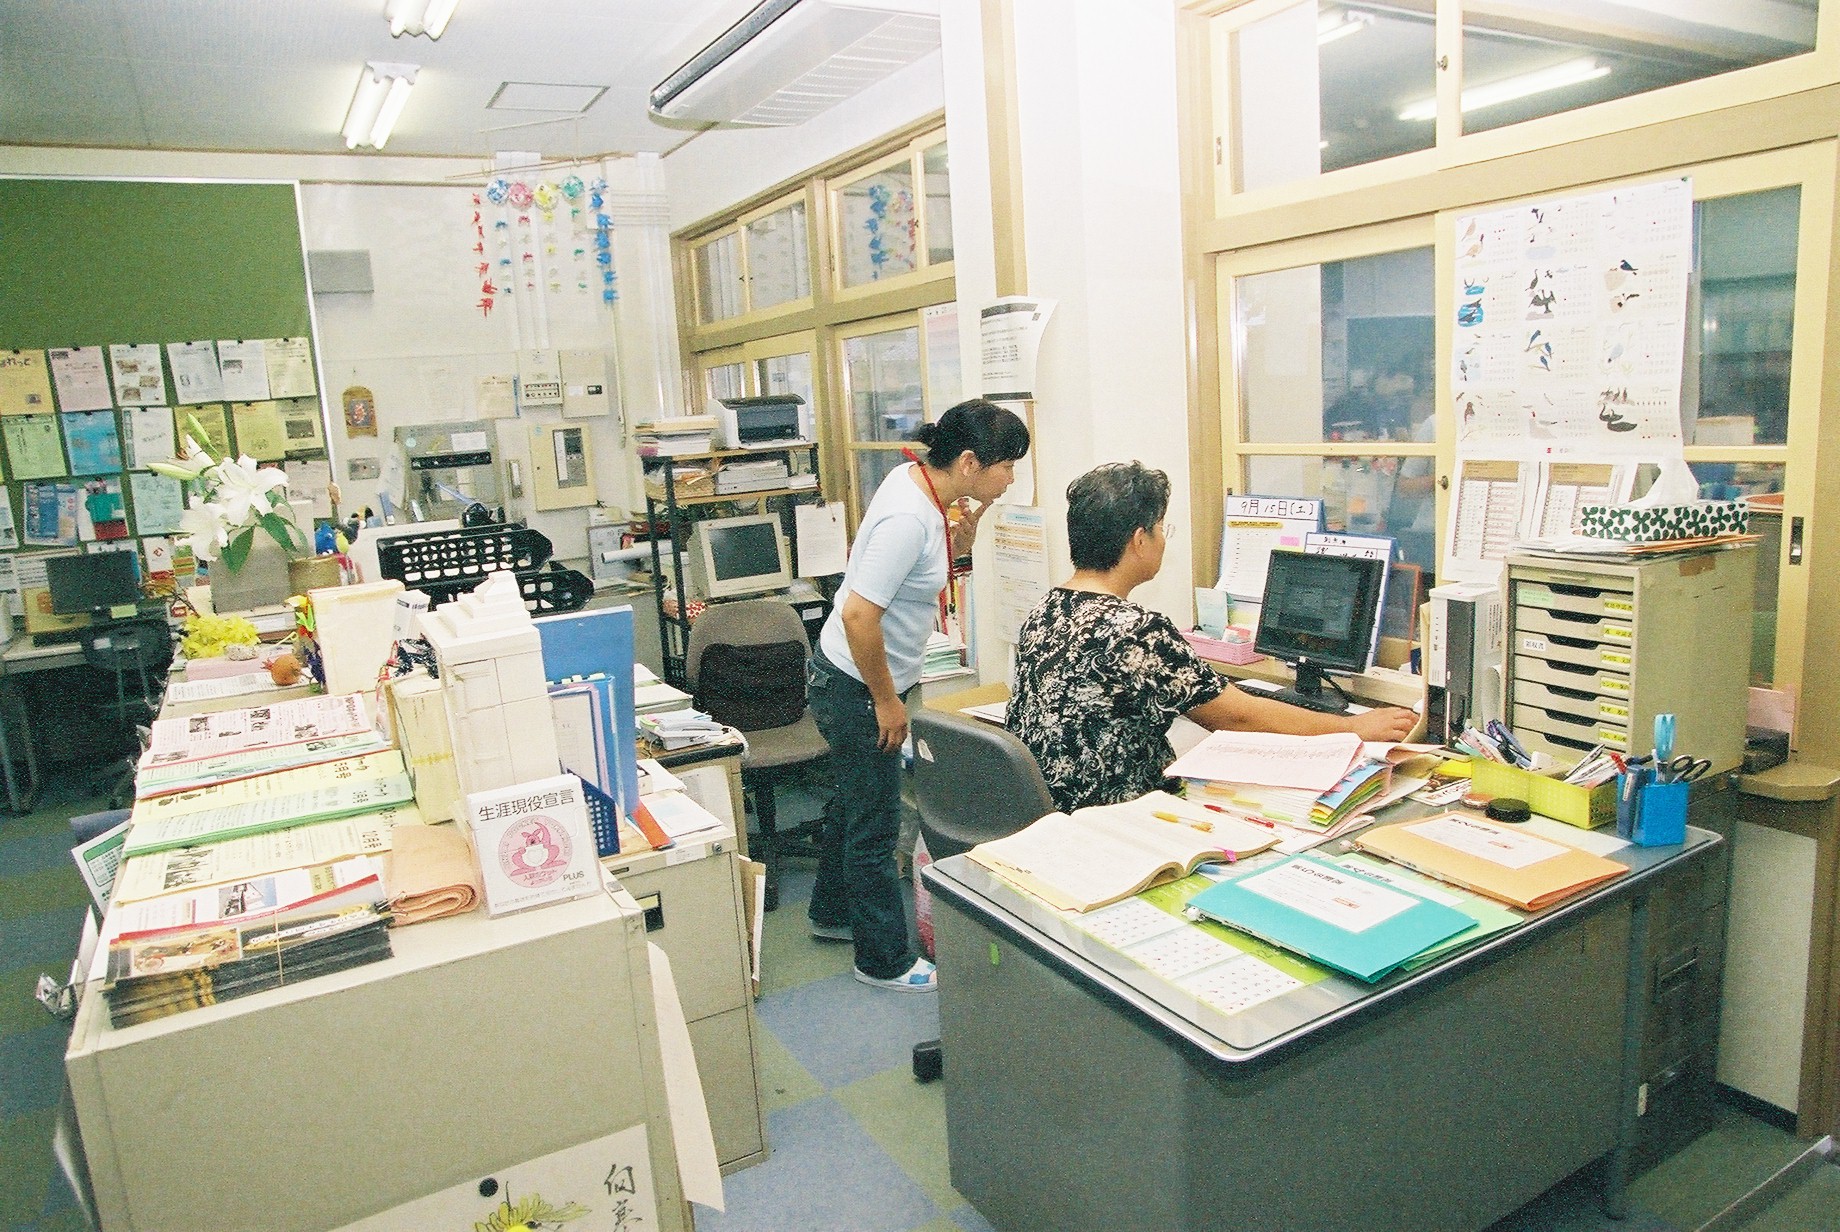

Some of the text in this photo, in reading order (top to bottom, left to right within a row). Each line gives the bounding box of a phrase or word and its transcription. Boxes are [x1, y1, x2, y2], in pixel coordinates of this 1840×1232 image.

[478, 788, 575, 822] 生涯現役宣言
[562, 870, 585, 881] PLUS
